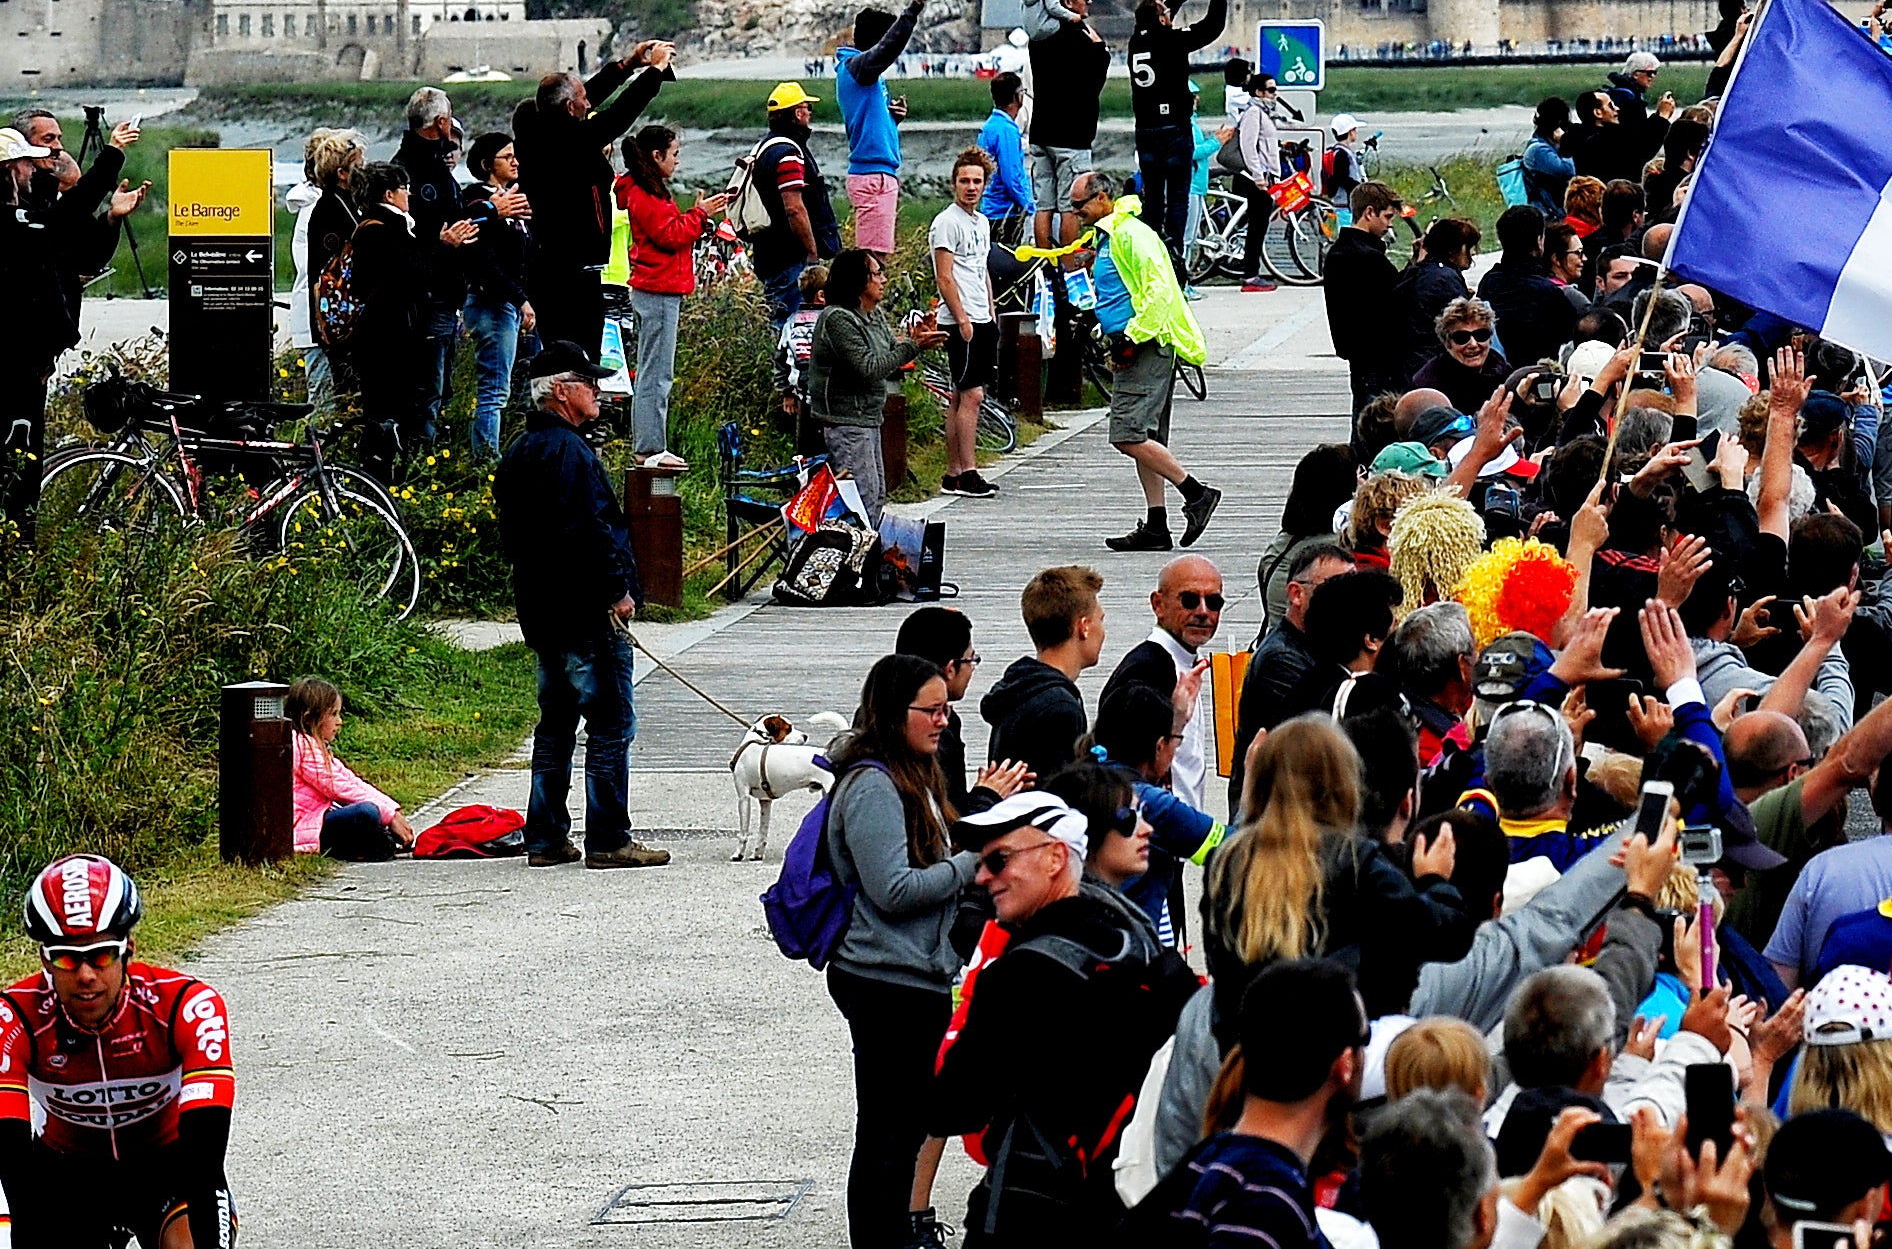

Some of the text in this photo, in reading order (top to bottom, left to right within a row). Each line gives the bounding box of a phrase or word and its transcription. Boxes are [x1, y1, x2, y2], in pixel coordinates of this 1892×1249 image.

[1132, 52, 1156, 88] 5
[174, 203, 240, 222] Le Barrage
[61, 859, 94, 927] AEROS
[52, 1081, 162, 1104] LOTTO
